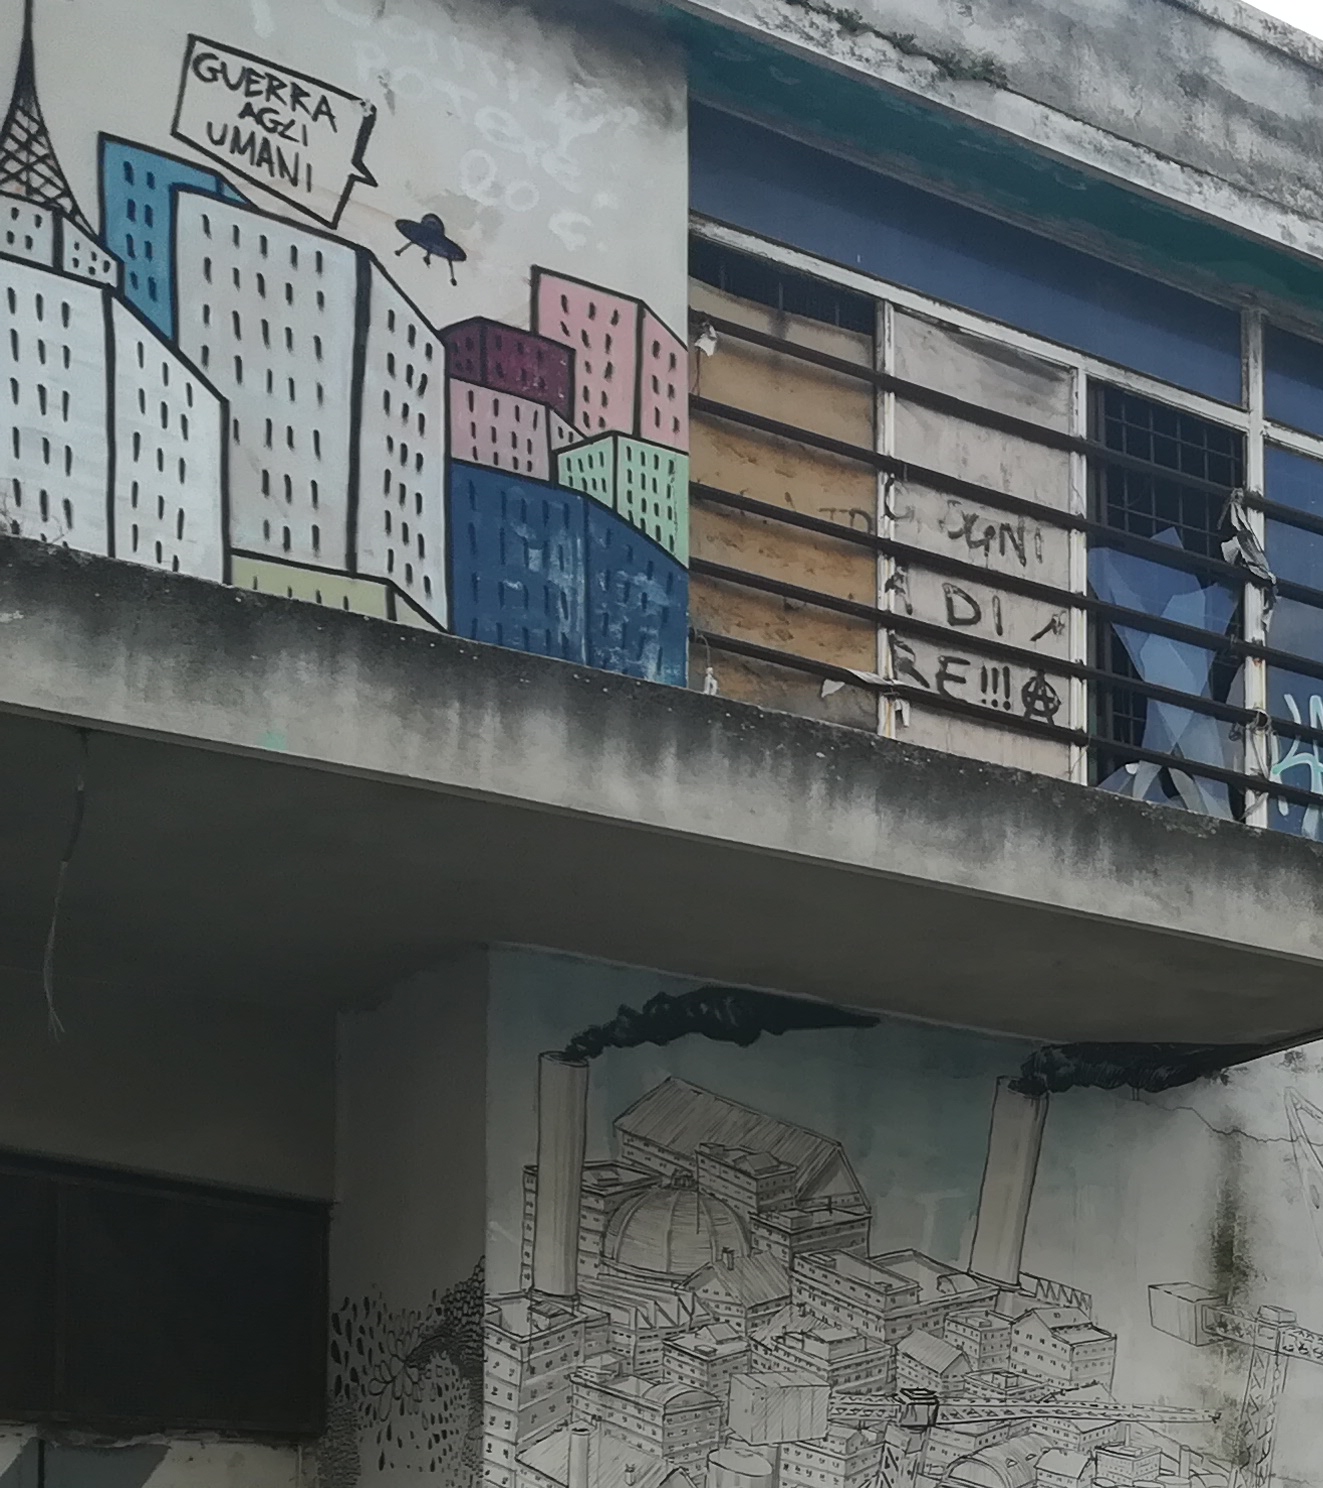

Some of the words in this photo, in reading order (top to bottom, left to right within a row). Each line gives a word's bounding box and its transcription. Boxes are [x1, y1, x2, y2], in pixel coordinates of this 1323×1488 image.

[191, 51, 341, 132] GUERRA
[237, 100, 309, 148] AGLI
[207, 120, 315, 194] UMANI
